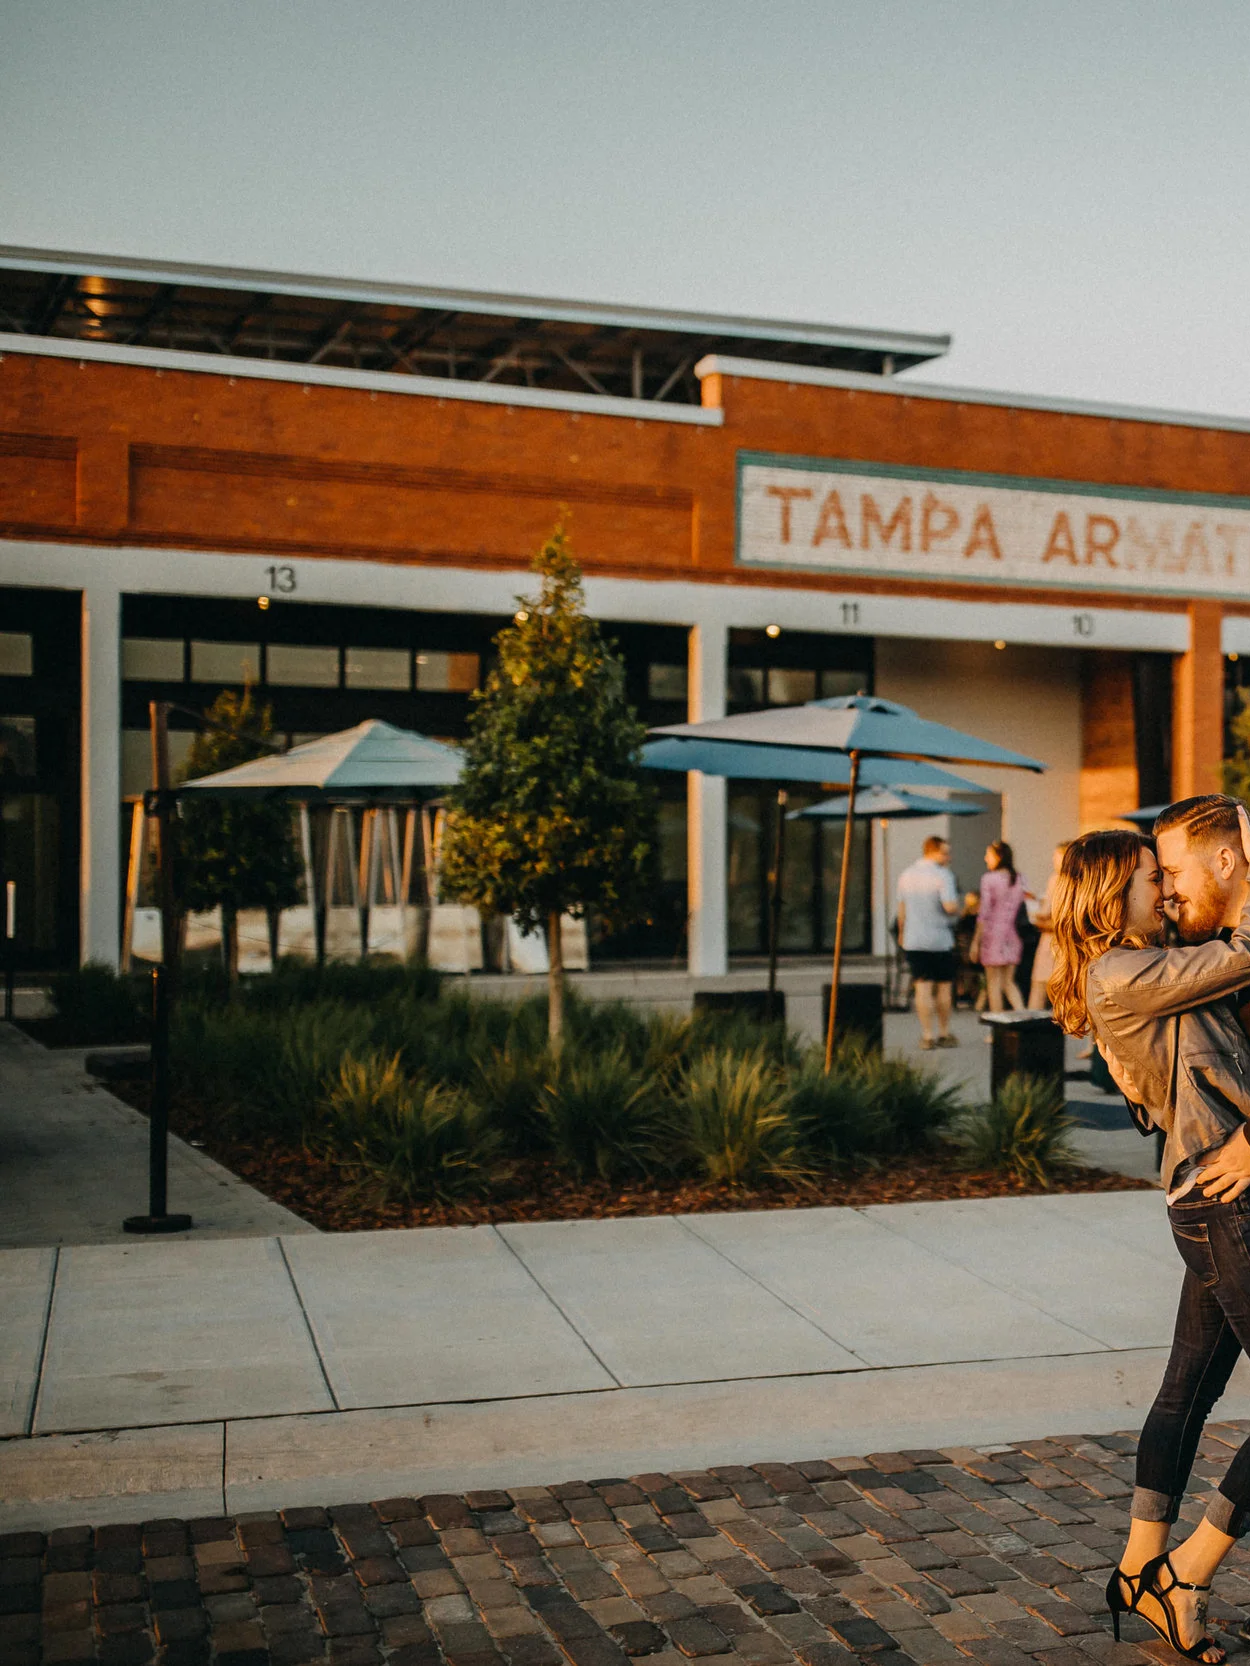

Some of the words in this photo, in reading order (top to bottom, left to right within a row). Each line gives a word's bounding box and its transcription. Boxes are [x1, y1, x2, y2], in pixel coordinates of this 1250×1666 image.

[766, 485, 1003, 560] TAMPA
[264, 565, 297, 594] 13
[839, 602, 860, 626] 11
[1073, 614, 1095, 638] 10
